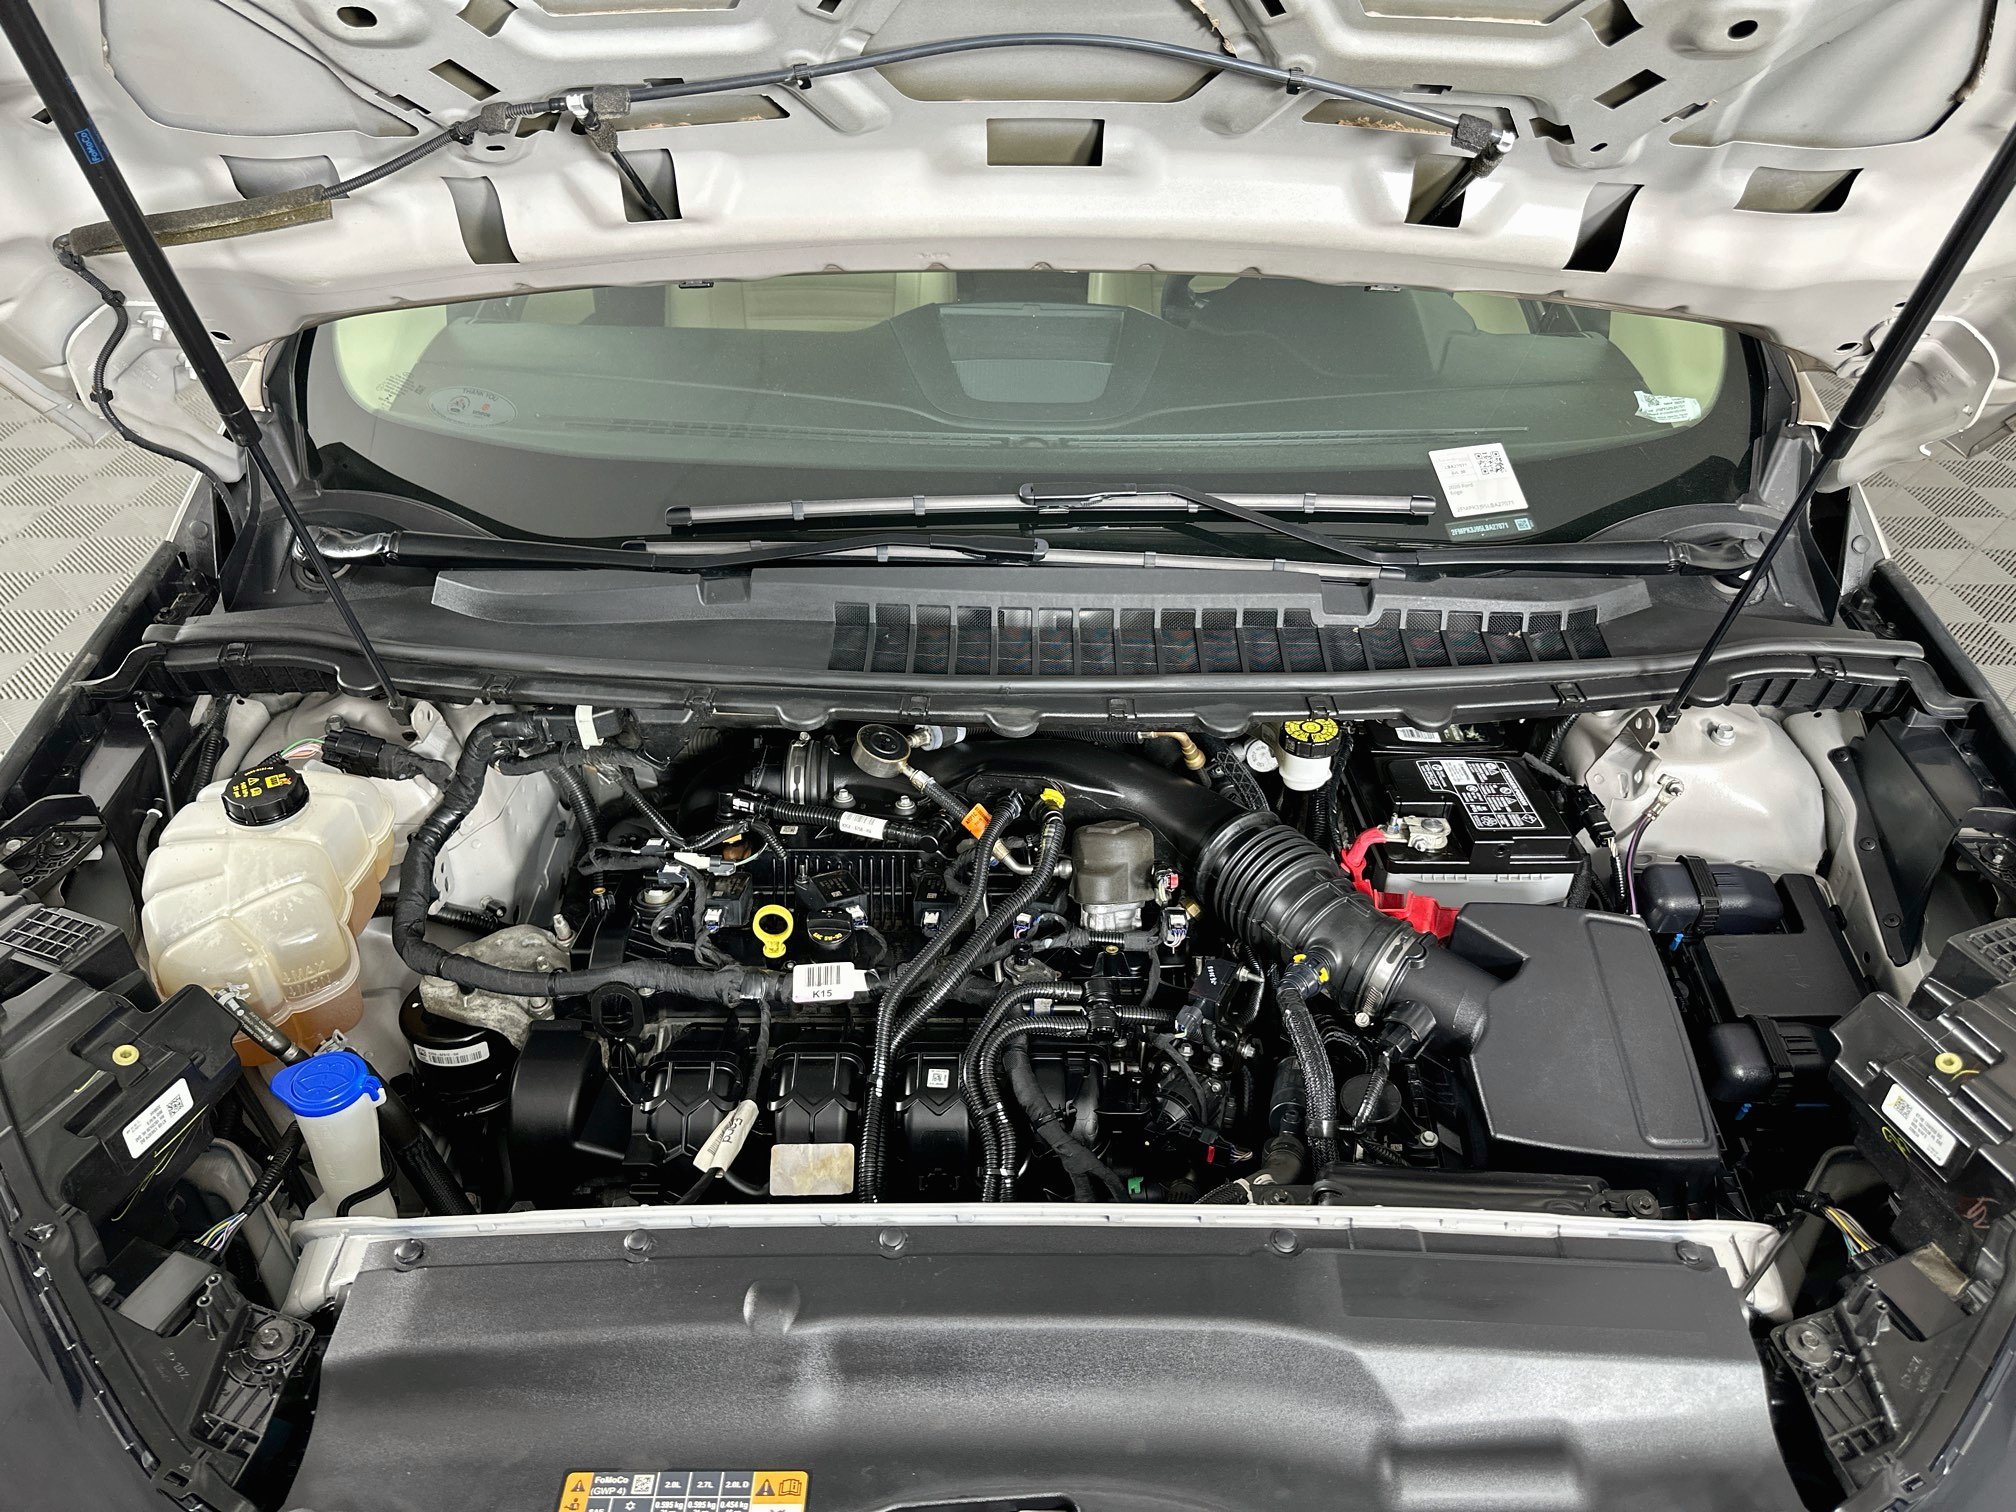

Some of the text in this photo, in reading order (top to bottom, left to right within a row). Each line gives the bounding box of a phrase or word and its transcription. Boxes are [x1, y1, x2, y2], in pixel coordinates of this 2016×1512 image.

[81, 132, 100, 161] FoMoCo
[812, 989, 833, 998] K15
[594, 1476, 629, 1484] FoMoCo
[696, 1481, 714, 1489] 2.7L
[590, 1486, 627, 1495] (GWP 4)
[674, 1501, 684, 1510] kg
[706, 1501, 716, 1510] kg
[739, 1501, 749, 1510] kg
